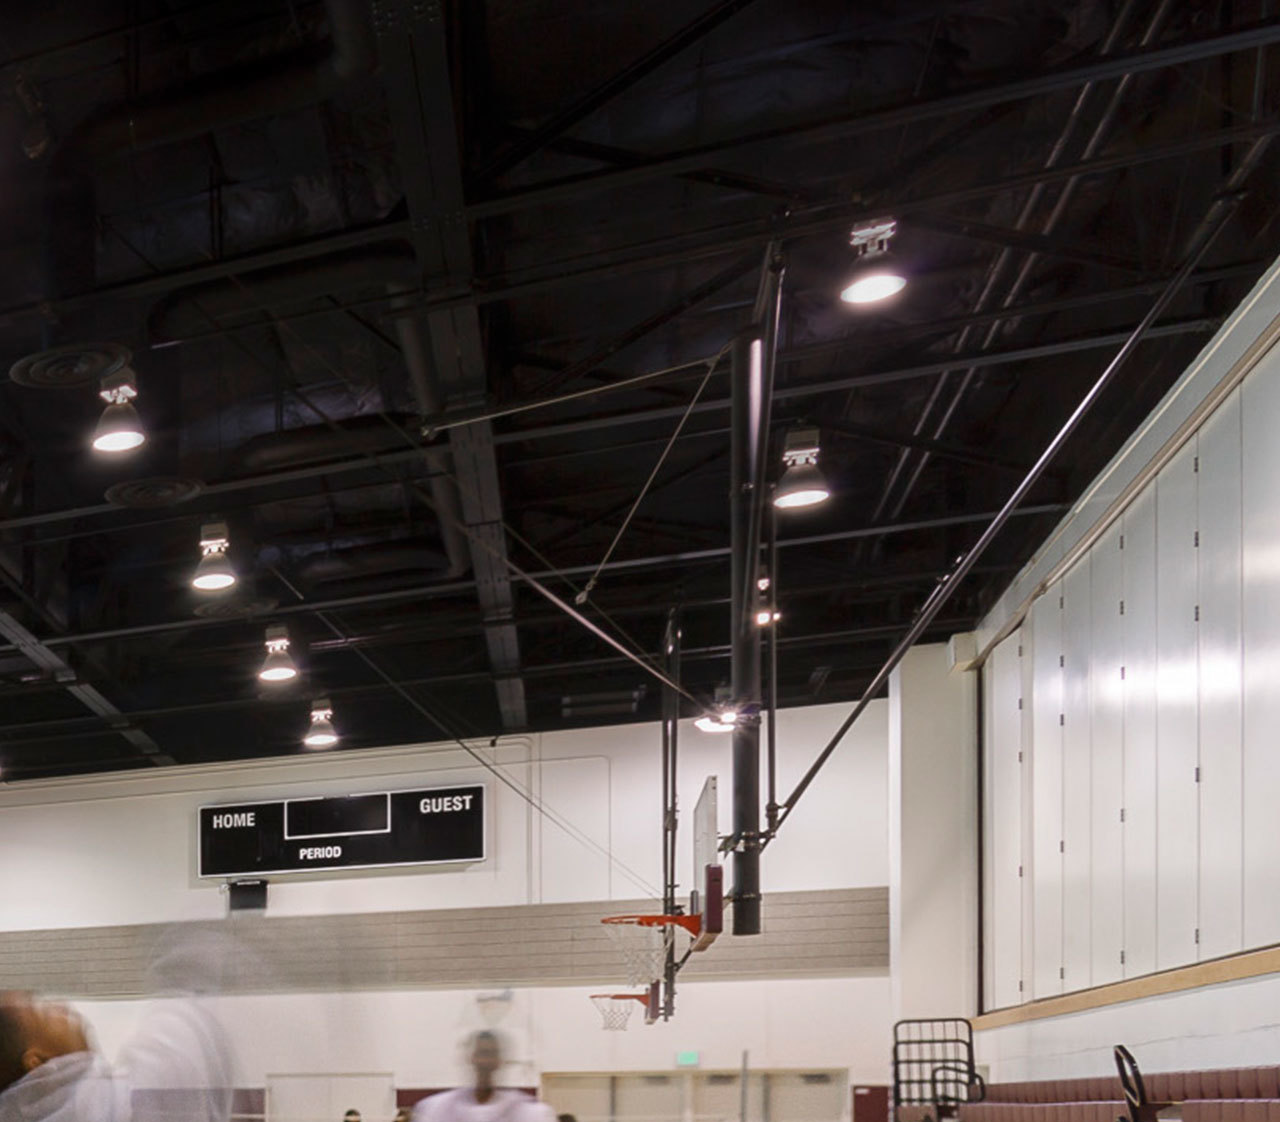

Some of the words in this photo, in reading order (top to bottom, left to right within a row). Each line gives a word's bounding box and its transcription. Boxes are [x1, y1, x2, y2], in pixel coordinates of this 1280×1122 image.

[420, 795, 472, 813] GUEST
[213, 813, 255, 828] HOME
[299, 846, 342, 860] PERIOD
